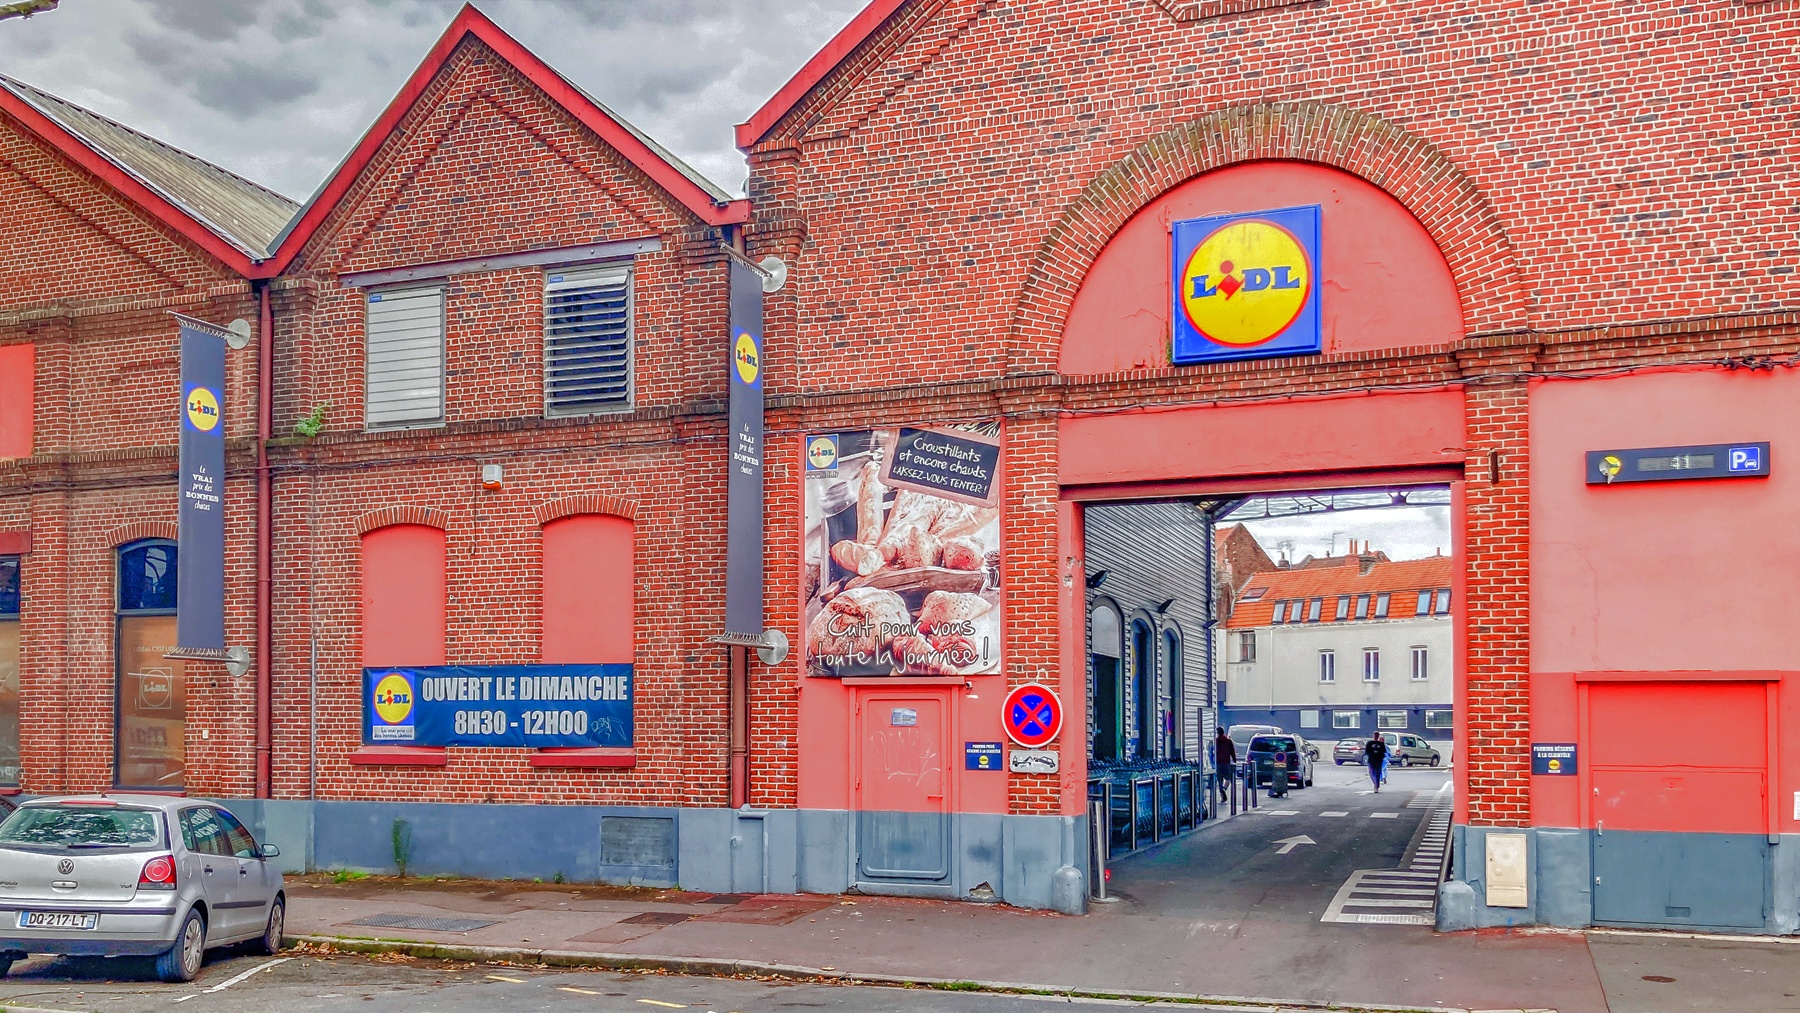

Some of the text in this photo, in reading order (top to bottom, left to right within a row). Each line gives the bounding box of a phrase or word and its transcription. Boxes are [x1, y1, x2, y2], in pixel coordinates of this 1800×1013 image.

[739, 433, 755, 444] VRAI
[913, 437, 981, 463] Croustillants
[734, 452, 759, 466] BONNES
[899, 450, 987, 480] et encore chauds,
[1732, 451, 1747, 468] P
[192, 474, 213, 483] VRAI
[892, 465, 948, 486] LAISSEZ-VOUS
[185, 491, 219, 502] BONNES
[827, 612, 976, 645] Cuit pour vous
[815, 641, 872, 666] toute
[874, 635, 893, 666] la
[897, 644, 979, 673] journée
[422, 676, 628, 701] OUVERT LE DIMANCHE
[454, 710, 506, 735] 8H30
[522, 710, 588, 735] 12H00
